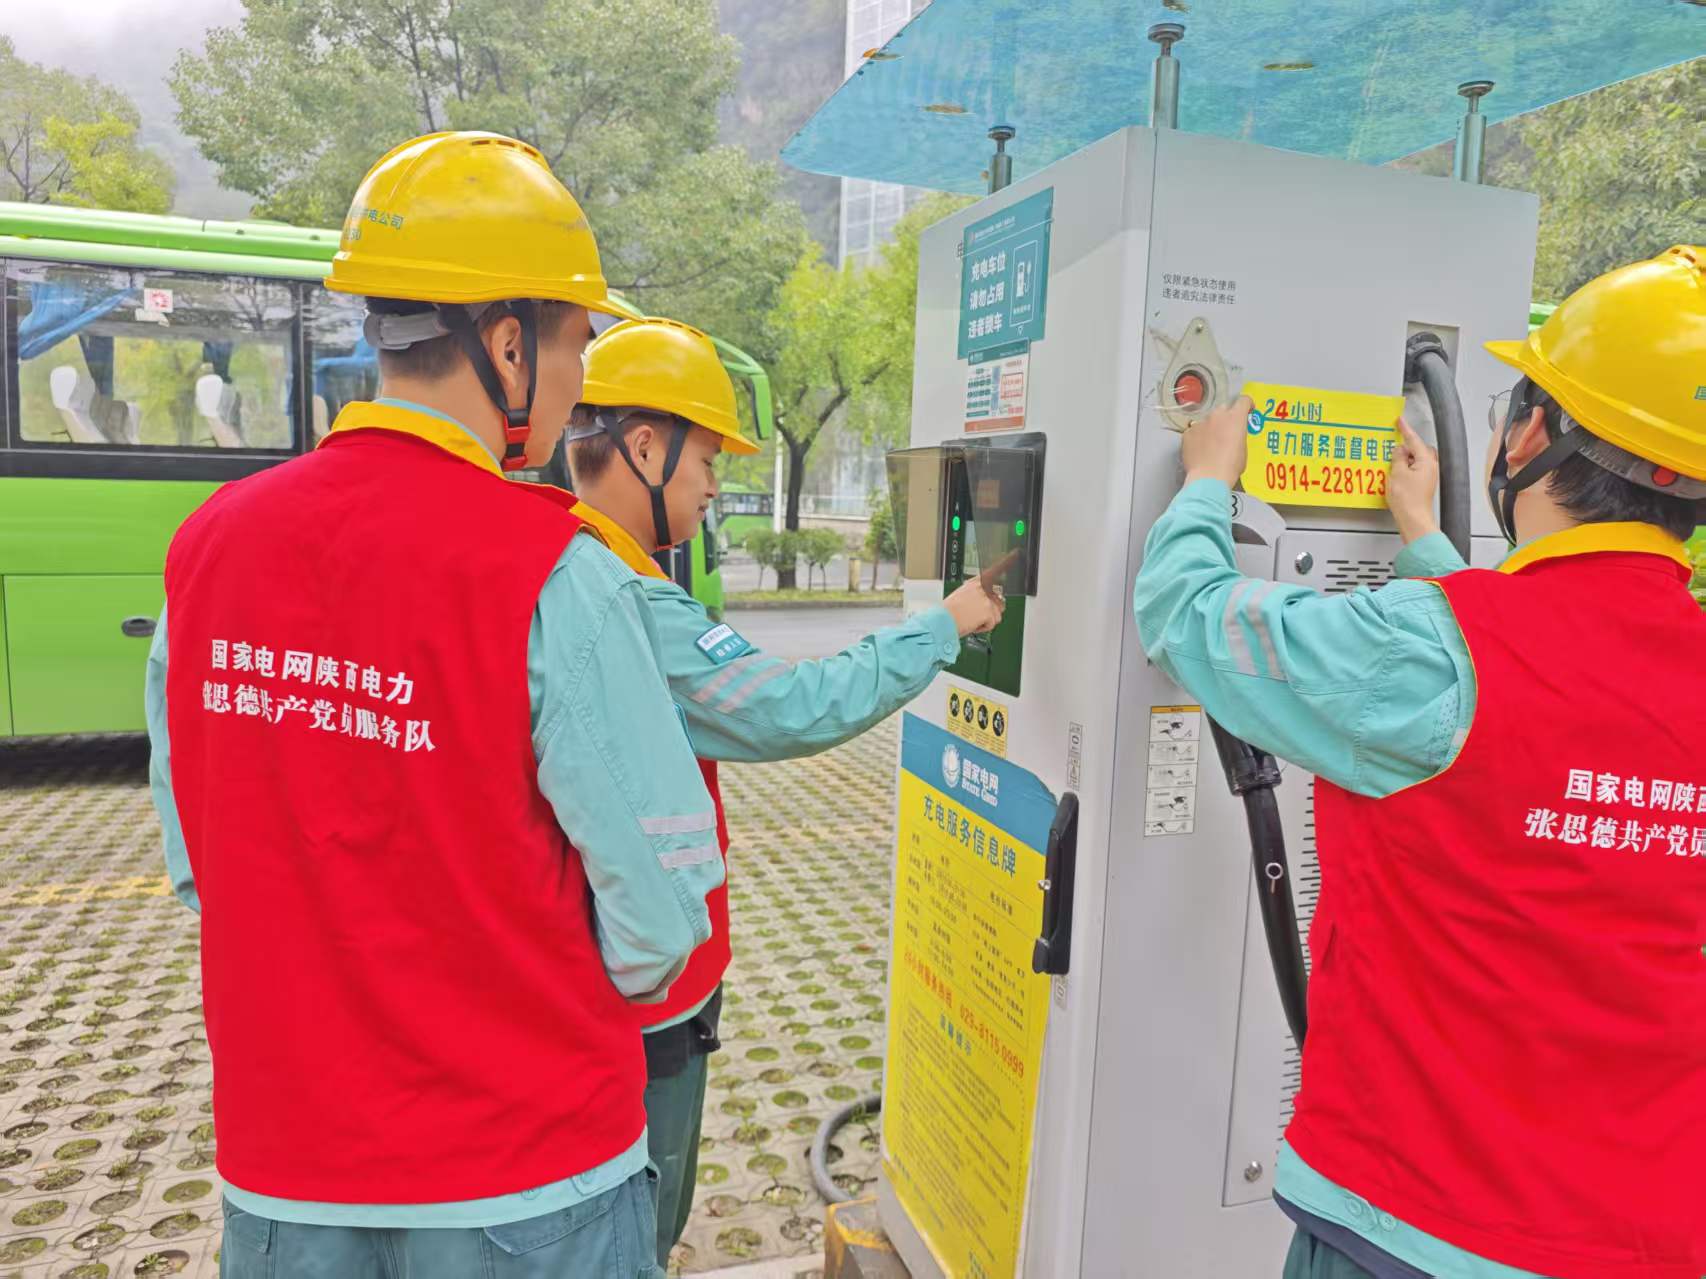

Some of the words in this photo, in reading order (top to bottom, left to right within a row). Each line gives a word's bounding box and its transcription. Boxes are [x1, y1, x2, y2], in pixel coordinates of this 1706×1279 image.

[971, 252, 1006, 282] 充电车位
[1162, 273, 1237, 291] 仅限紧急状态使用
[969, 281, 1005, 311] 请勿占用
[1162, 287, 1236, 305] 违者追究法律责任
[1264, 398, 1323, 422] 24小时
[1266, 430, 1395, 462] 电力服务监督电话
[962, 758, 999, 795] 国家电网
[923, 794, 1016, 879] 充电服务信息牌
